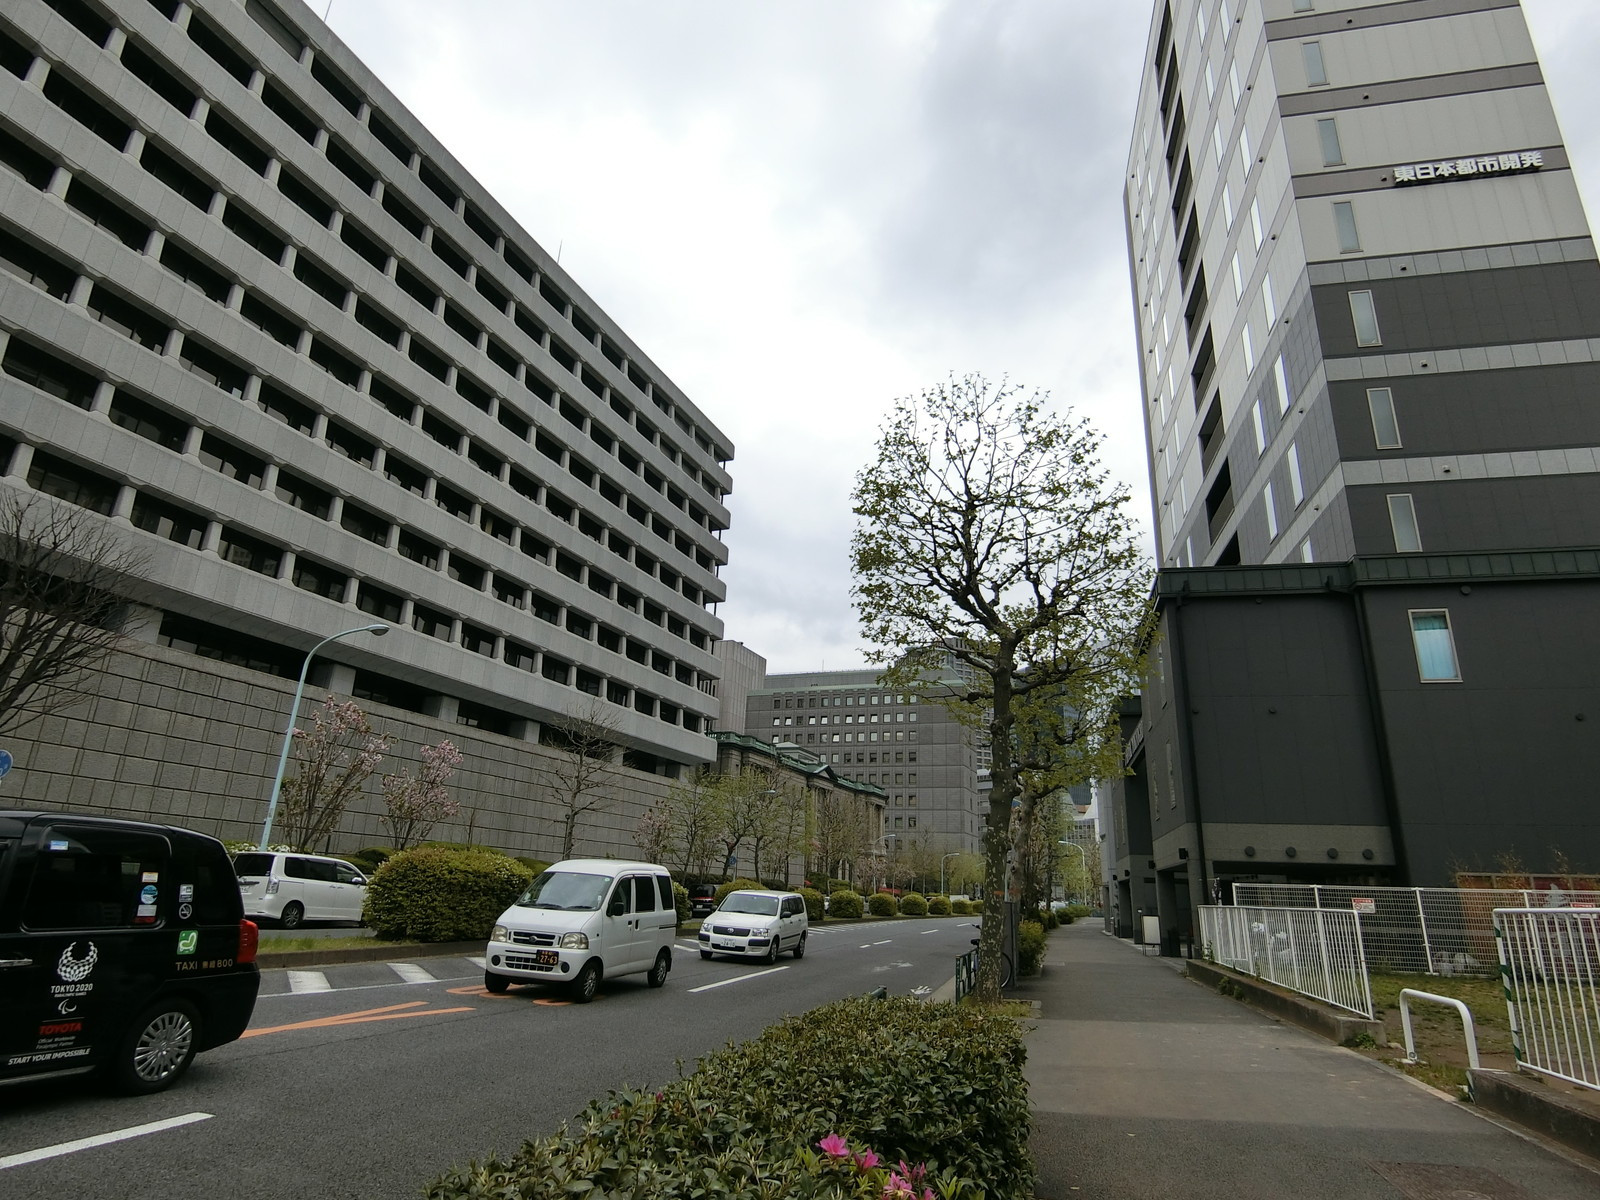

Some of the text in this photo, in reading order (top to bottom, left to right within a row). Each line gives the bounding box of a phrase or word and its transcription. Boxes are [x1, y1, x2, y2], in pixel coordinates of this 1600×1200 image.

[1393, 151, 1544, 182] 東日本都市開発
[175, 961, 198, 971] TAXI
[51, 983, 94, 993] TOKYO 2020
[40, 1022, 81, 1034] TOYOTA
[8, 1048, 91, 1066] START YOUR IMPOSSIBLE
